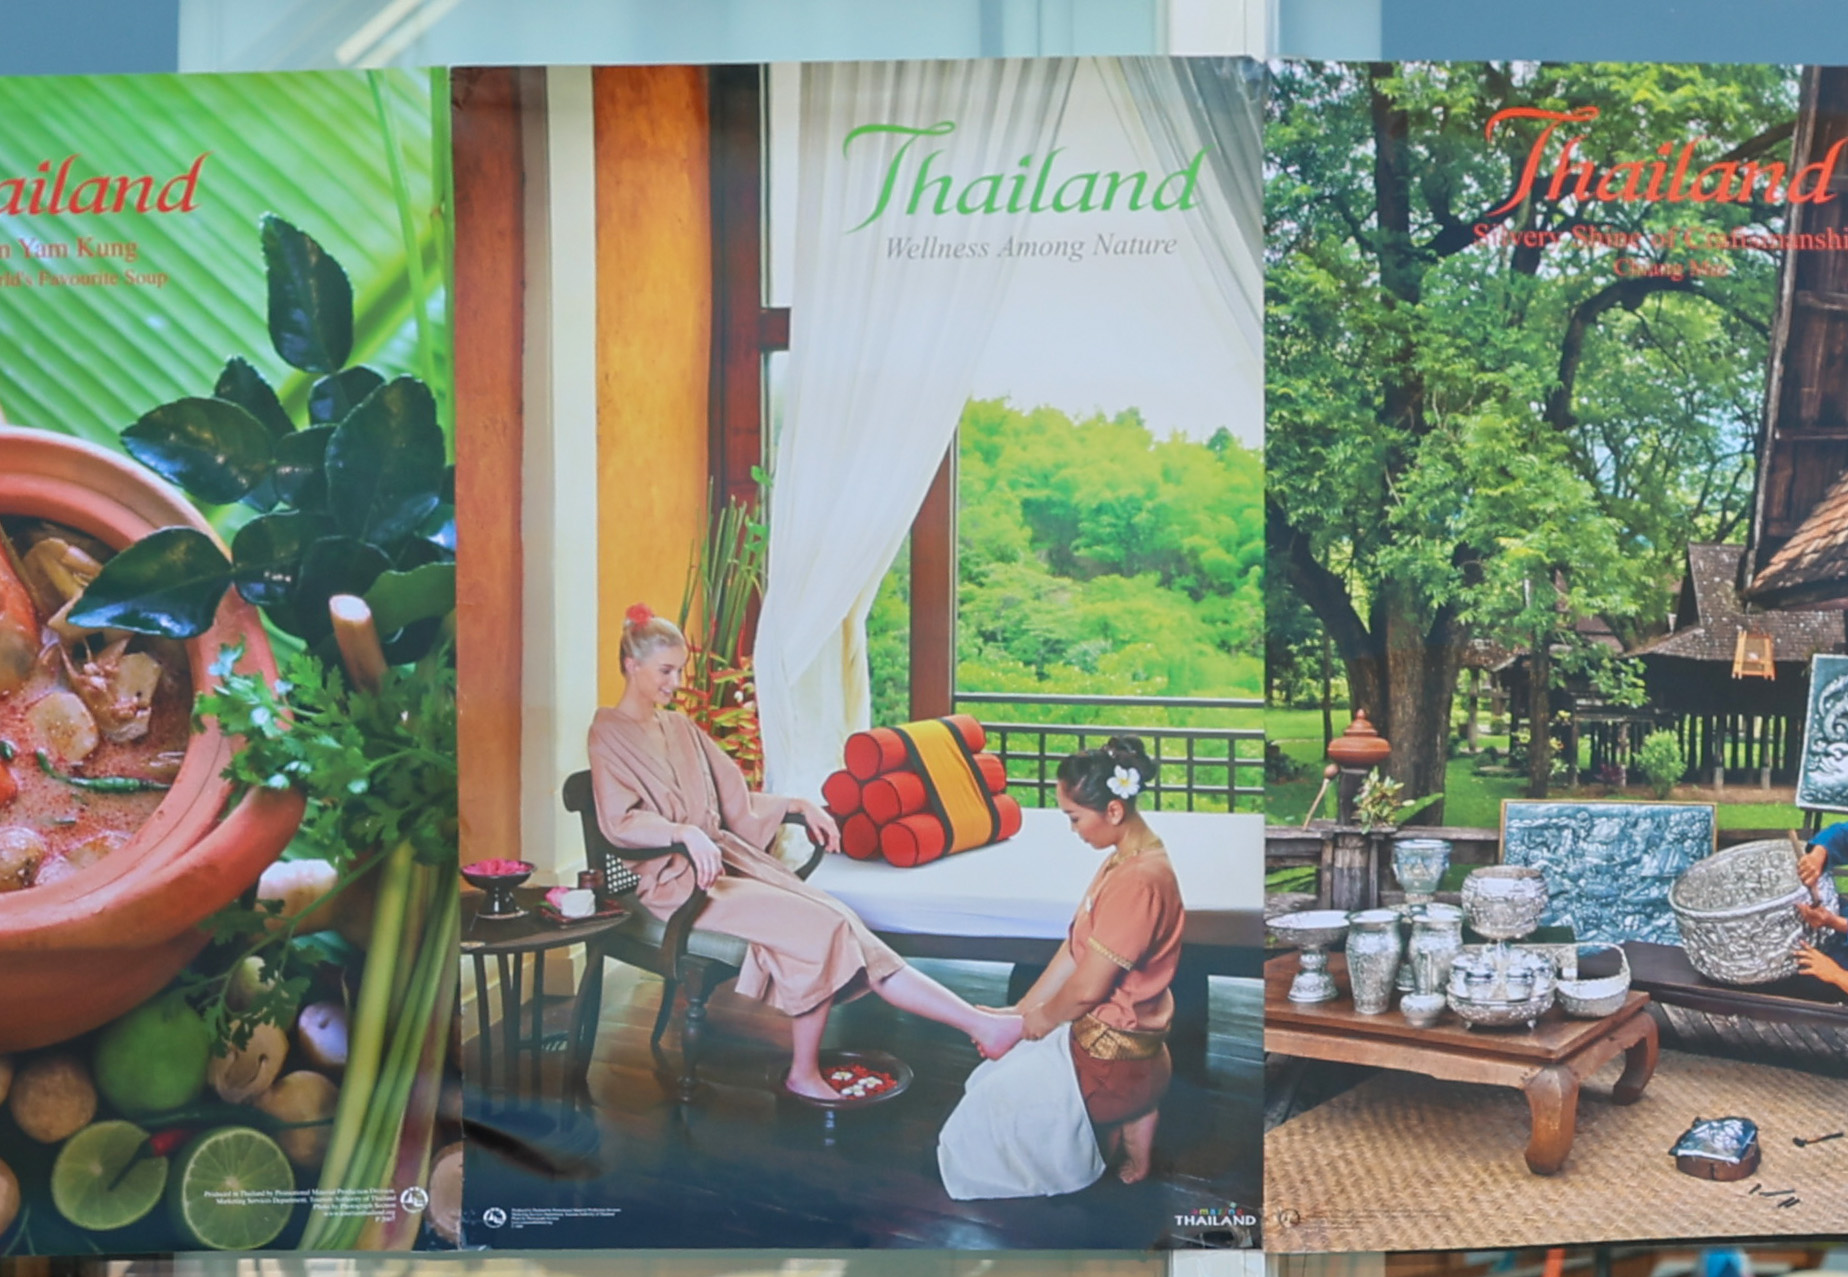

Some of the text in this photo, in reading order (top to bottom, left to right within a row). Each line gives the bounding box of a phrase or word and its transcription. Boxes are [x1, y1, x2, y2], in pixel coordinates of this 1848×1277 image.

[842, 120, 1215, 235] Thailand
[18, 238, 69, 260] Yam
[76, 236, 139, 262] Kung
[886, 233, 1178, 263] Wellness Among Nature
[1472, 223, 1561, 253] Silvery
[1571, 224, 1641, 250] Shine
[1651, 225, 1677, 250] of
[38, 269, 119, 287] Favourite
[124, 269, 169, 289] Soup
[1613, 257, 1730, 283] Chiang Mai
[1174, 1215, 1257, 1226] THAILAND
